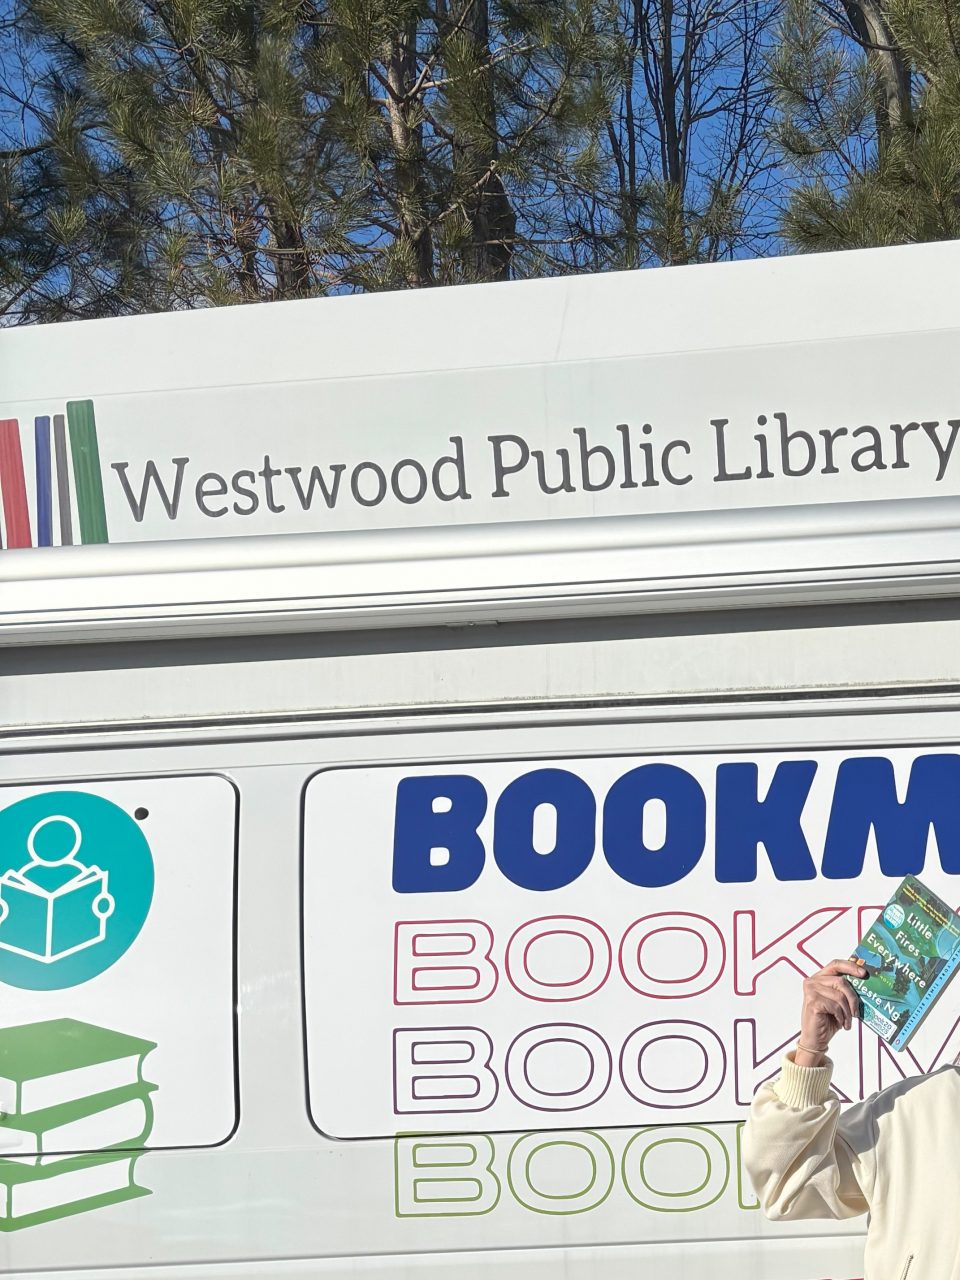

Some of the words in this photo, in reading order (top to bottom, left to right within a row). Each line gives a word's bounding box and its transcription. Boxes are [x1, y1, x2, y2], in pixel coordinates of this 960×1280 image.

[111, 436, 472, 523] Westwood
[488, 427, 694, 501] Public
[907, 913, 932, 940] Little
[896, 931, 920, 956] Fires
[867, 933, 926, 988] Everywhere
[884, 1003, 900, 1022] Ng
